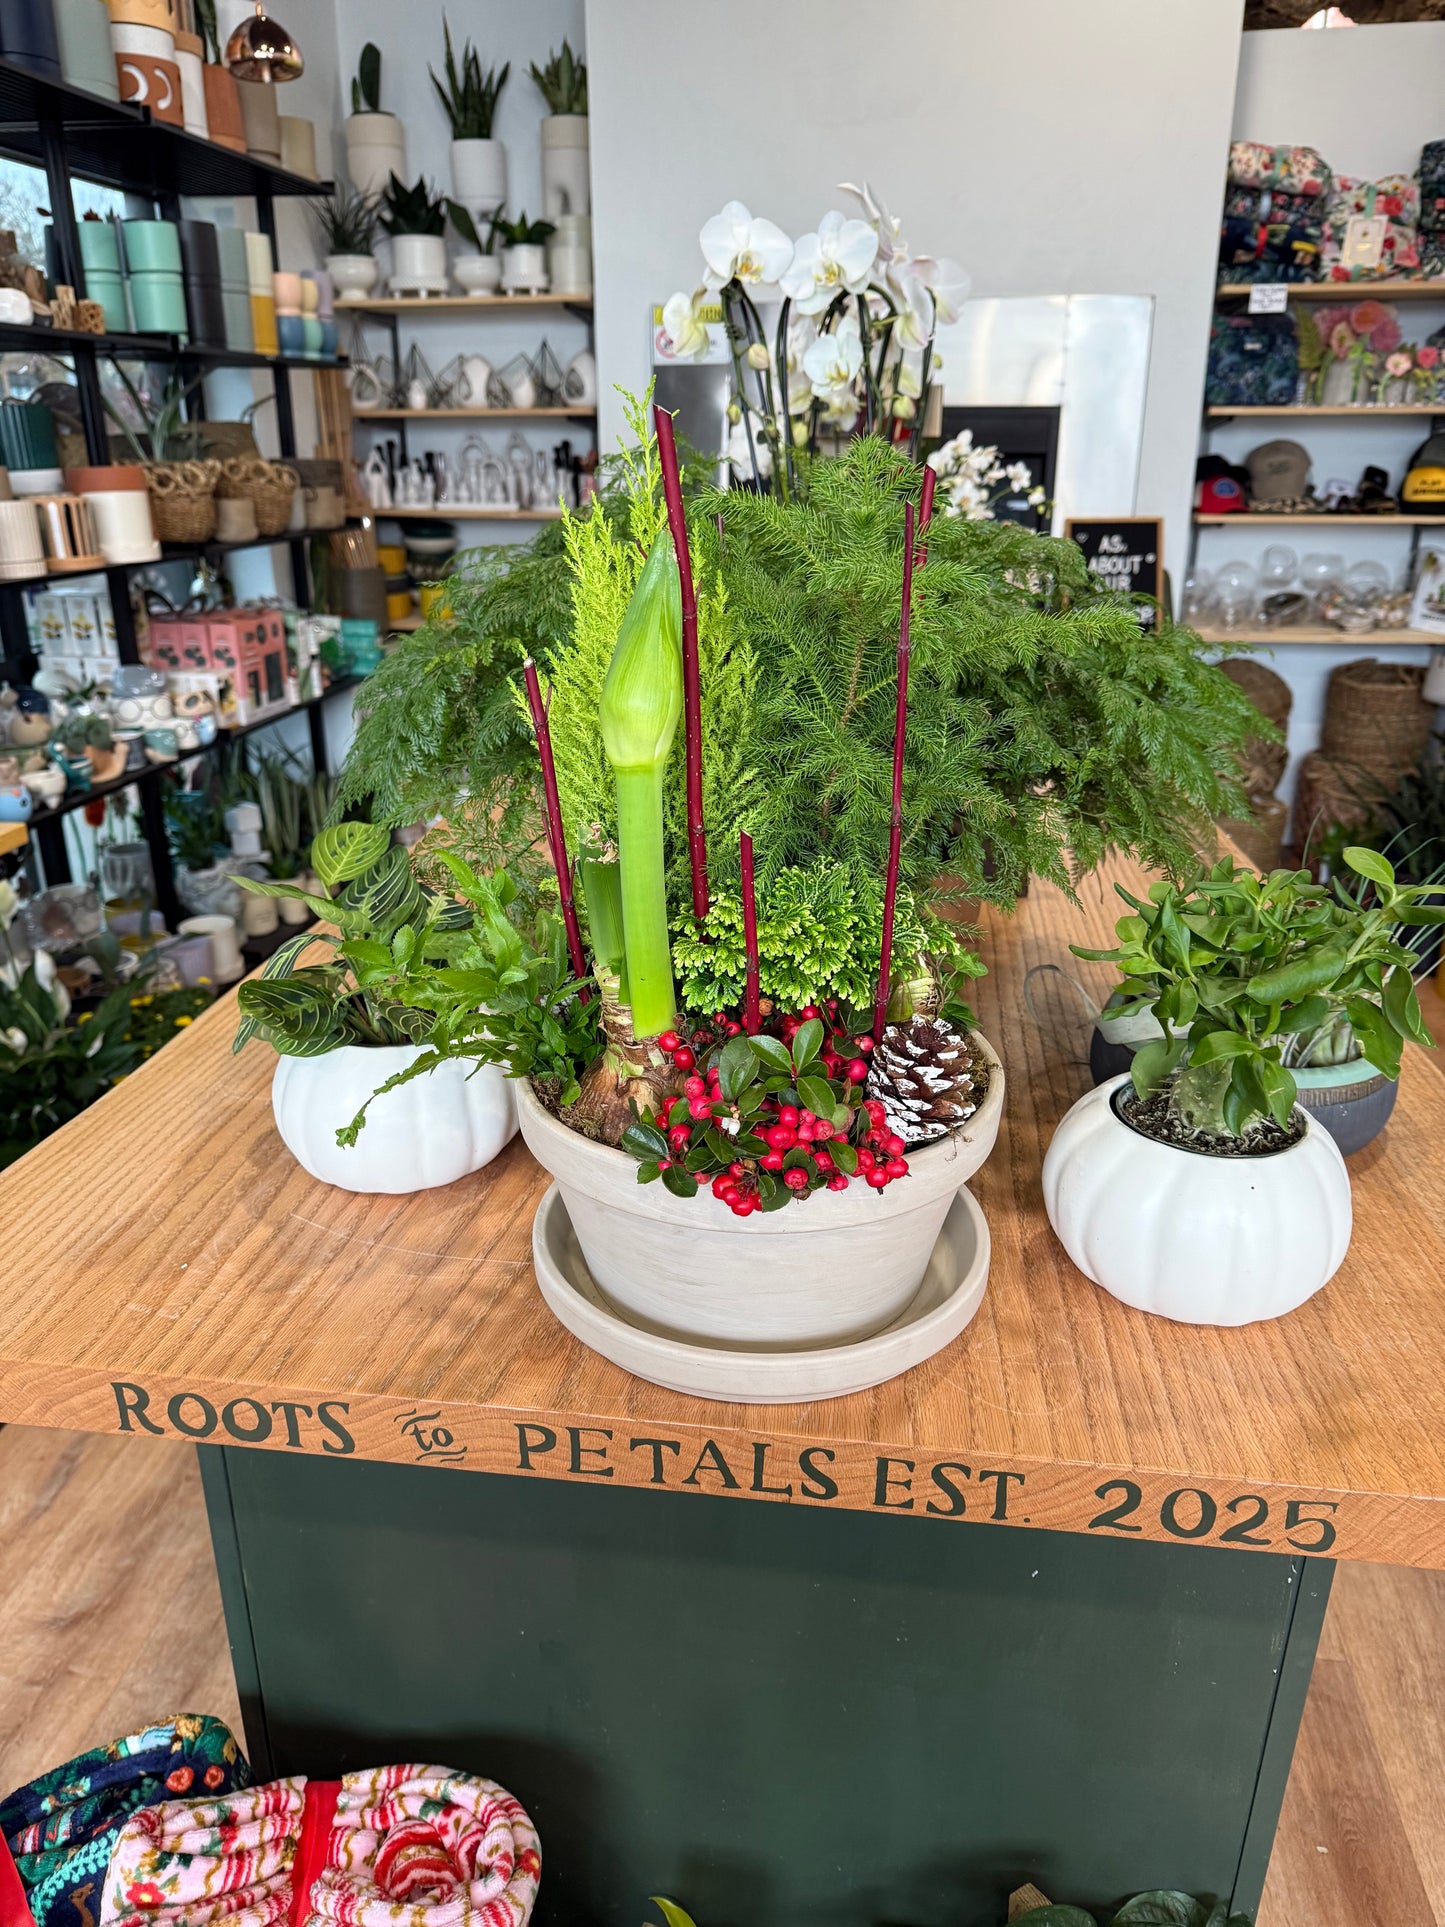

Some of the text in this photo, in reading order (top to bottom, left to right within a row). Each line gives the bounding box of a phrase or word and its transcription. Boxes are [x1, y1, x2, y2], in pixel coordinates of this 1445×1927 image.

[1087, 554, 1143, 575] ABOUT
[111, 1382, 1338, 1553] ROOTS to PETALS EST. 2025
